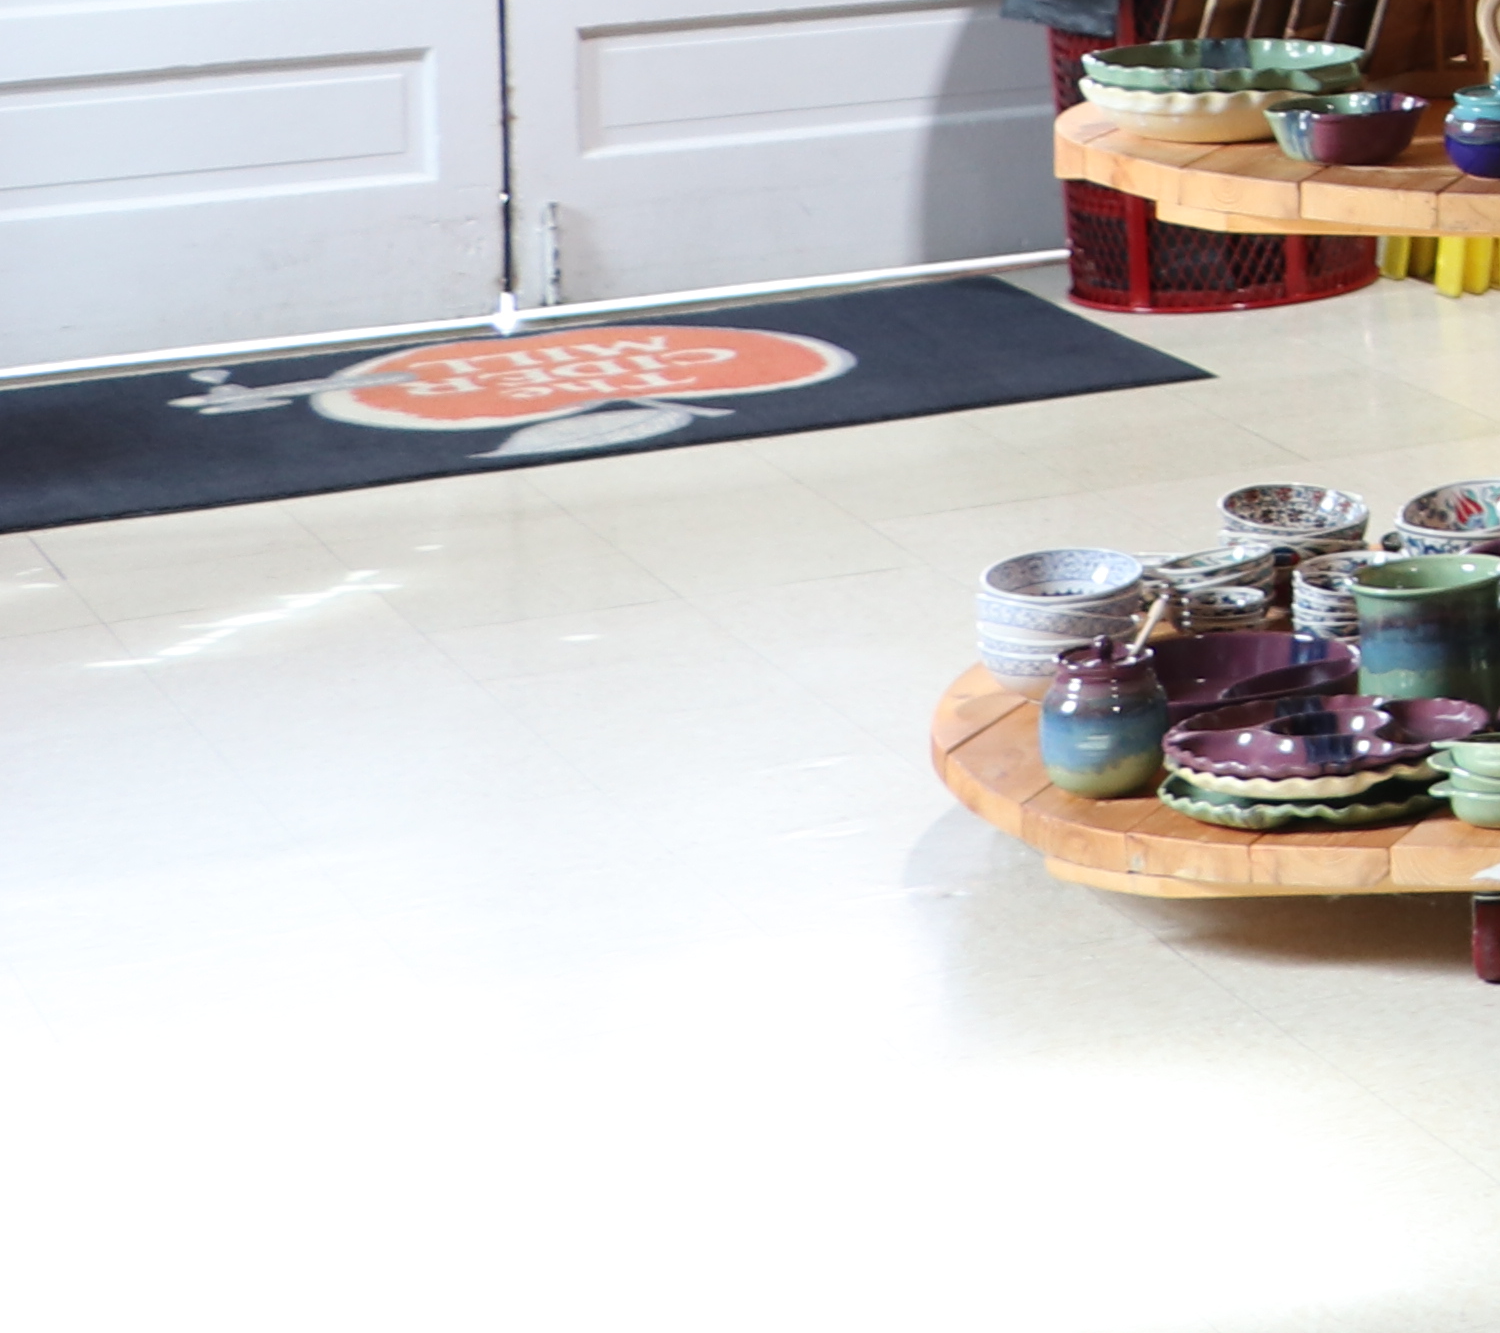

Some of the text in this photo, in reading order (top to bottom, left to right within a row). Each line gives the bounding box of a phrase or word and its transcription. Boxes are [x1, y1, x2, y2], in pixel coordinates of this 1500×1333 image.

[406, 347, 737, 396] CIDER
[407, 335, 667, 375] MILL
[510, 371, 697, 399] The
